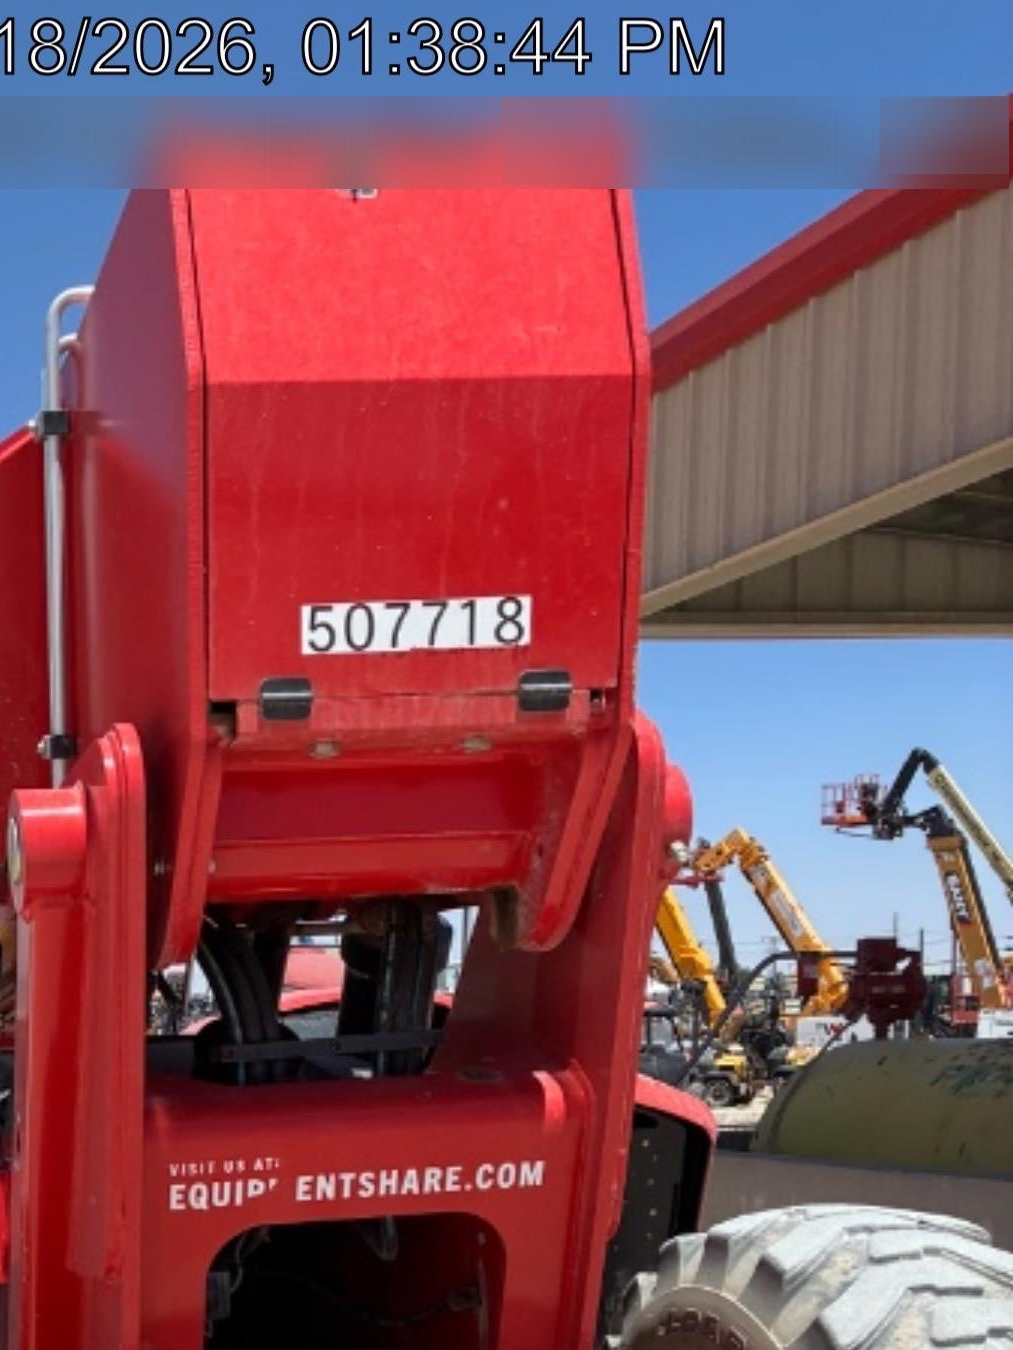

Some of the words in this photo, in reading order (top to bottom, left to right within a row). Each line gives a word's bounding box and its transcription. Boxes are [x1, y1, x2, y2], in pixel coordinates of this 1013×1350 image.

[307, 596, 525, 652] 507718
[168, 1160, 546, 1210] EQUIPENTSHARE.COM
[169, 1162, 215, 1178] VISIT
